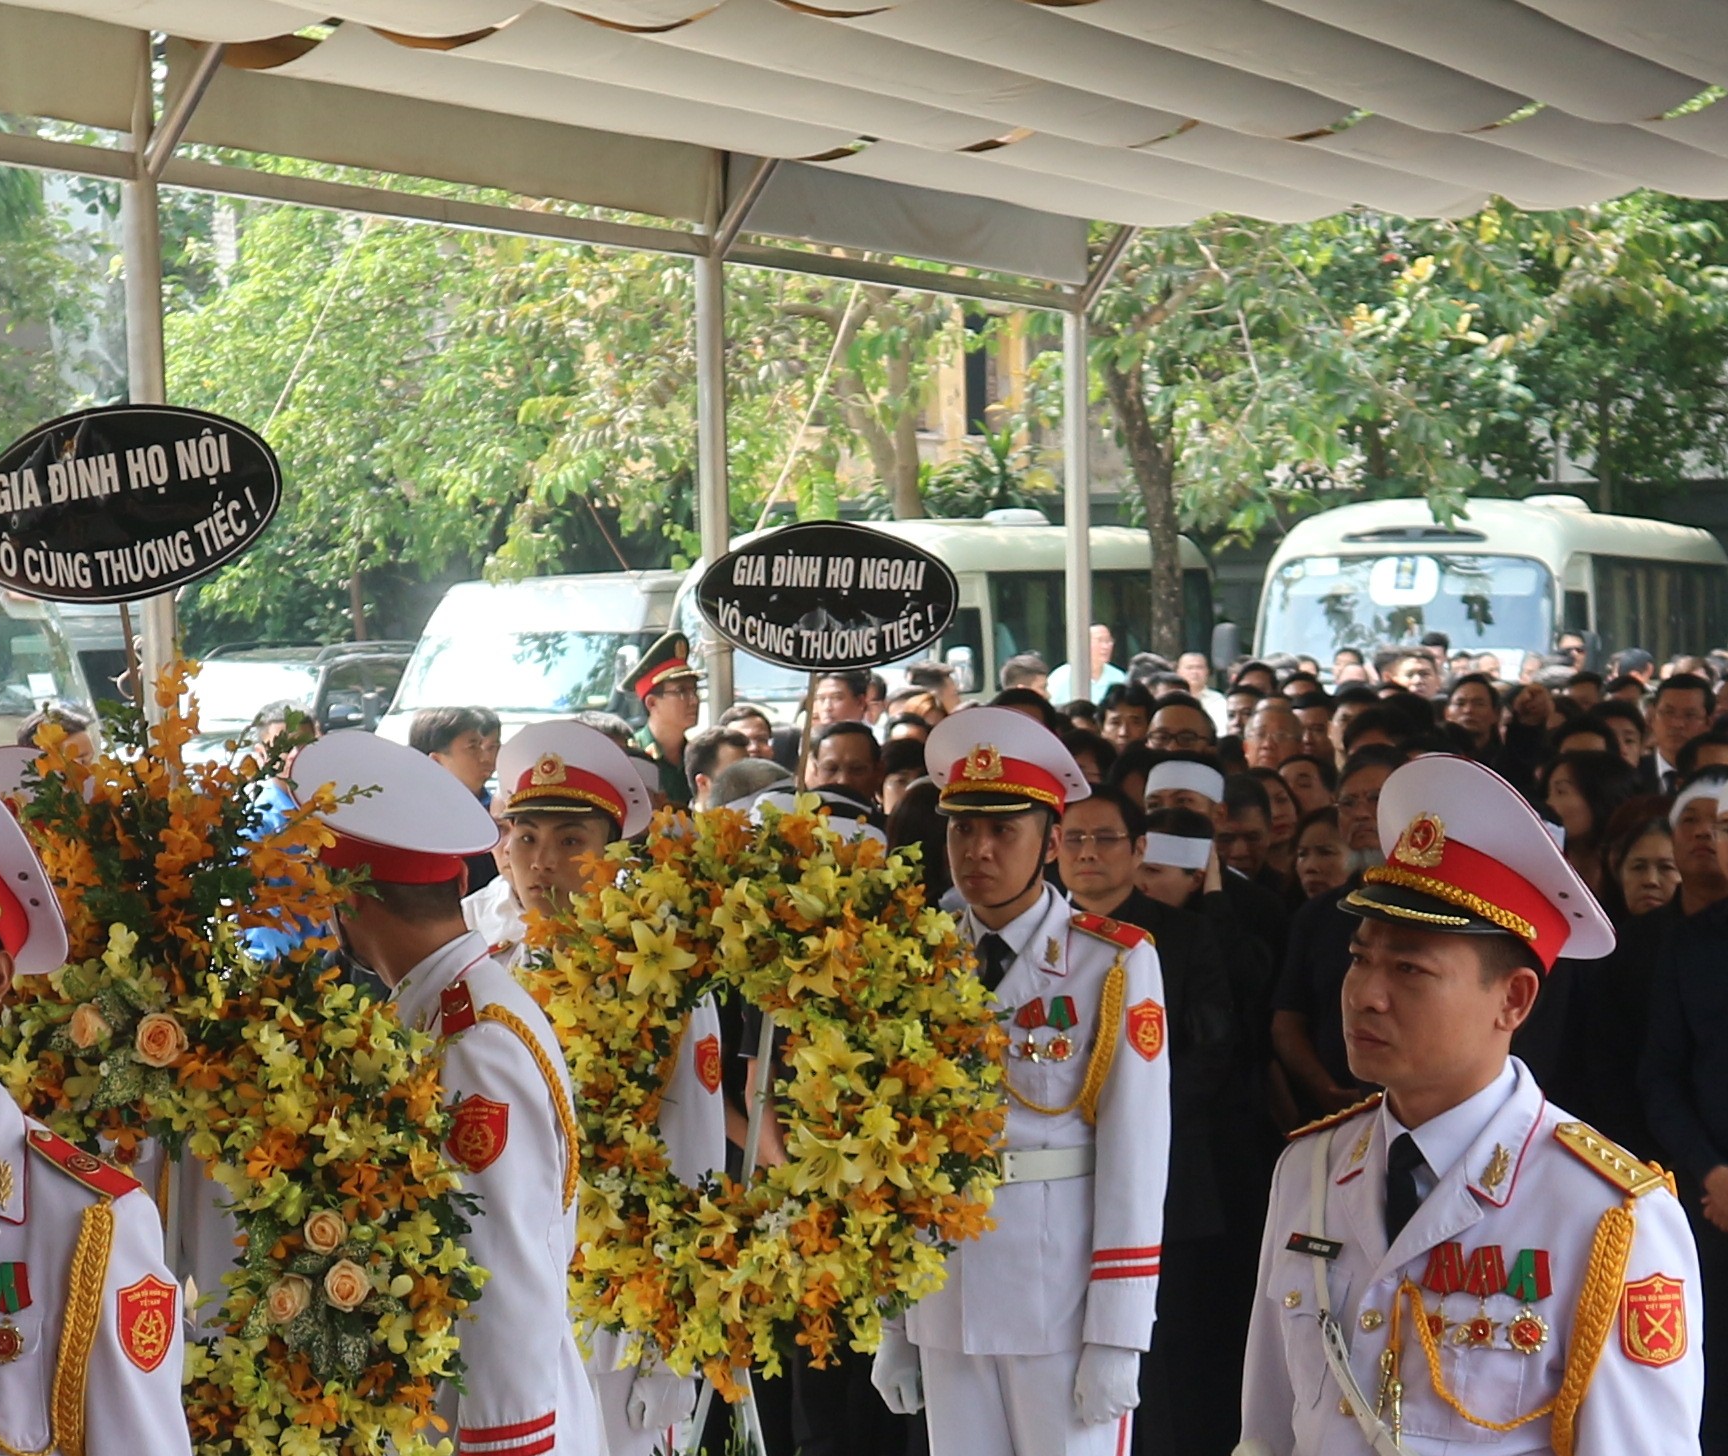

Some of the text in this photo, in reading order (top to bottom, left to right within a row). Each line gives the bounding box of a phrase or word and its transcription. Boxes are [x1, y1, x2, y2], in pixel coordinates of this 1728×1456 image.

[126, 444, 169, 494] HỌ
[175, 427, 232, 486] NỘI
[23, 540, 93, 590] CÙNG
[94, 529, 196, 587] THƯƠNG
[194, 491, 248, 557] TIẾC
[732, 548, 927, 598] GIA ĐÌNH HỌ NGOẠI
[717, 597, 741, 637] VÔ
[744, 612, 795, 657] CÙNG
[799, 626, 877, 660] THƯƠNG
[881, 602, 922, 652] TIẾC
